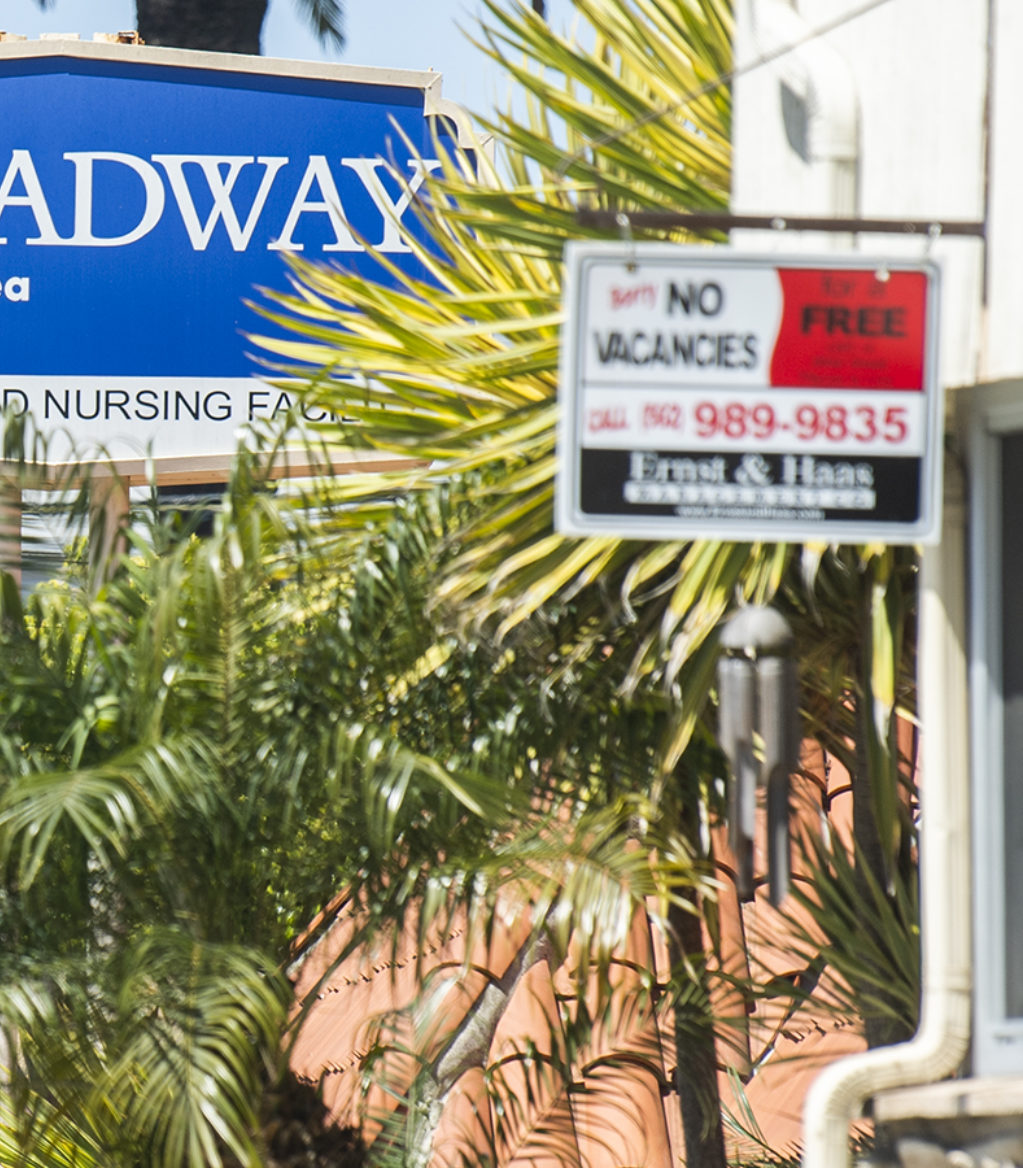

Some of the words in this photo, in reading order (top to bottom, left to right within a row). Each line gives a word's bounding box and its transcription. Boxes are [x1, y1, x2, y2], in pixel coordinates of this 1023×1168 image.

[667, 281, 724, 318] NO
[800, 304, 909, 339] FREE
[593, 330, 759, 369] VACANCIES
[44, 388, 233, 421] NURSING
[693, 400, 911, 445] 989-9835
[733, 451, 775, 487] &
